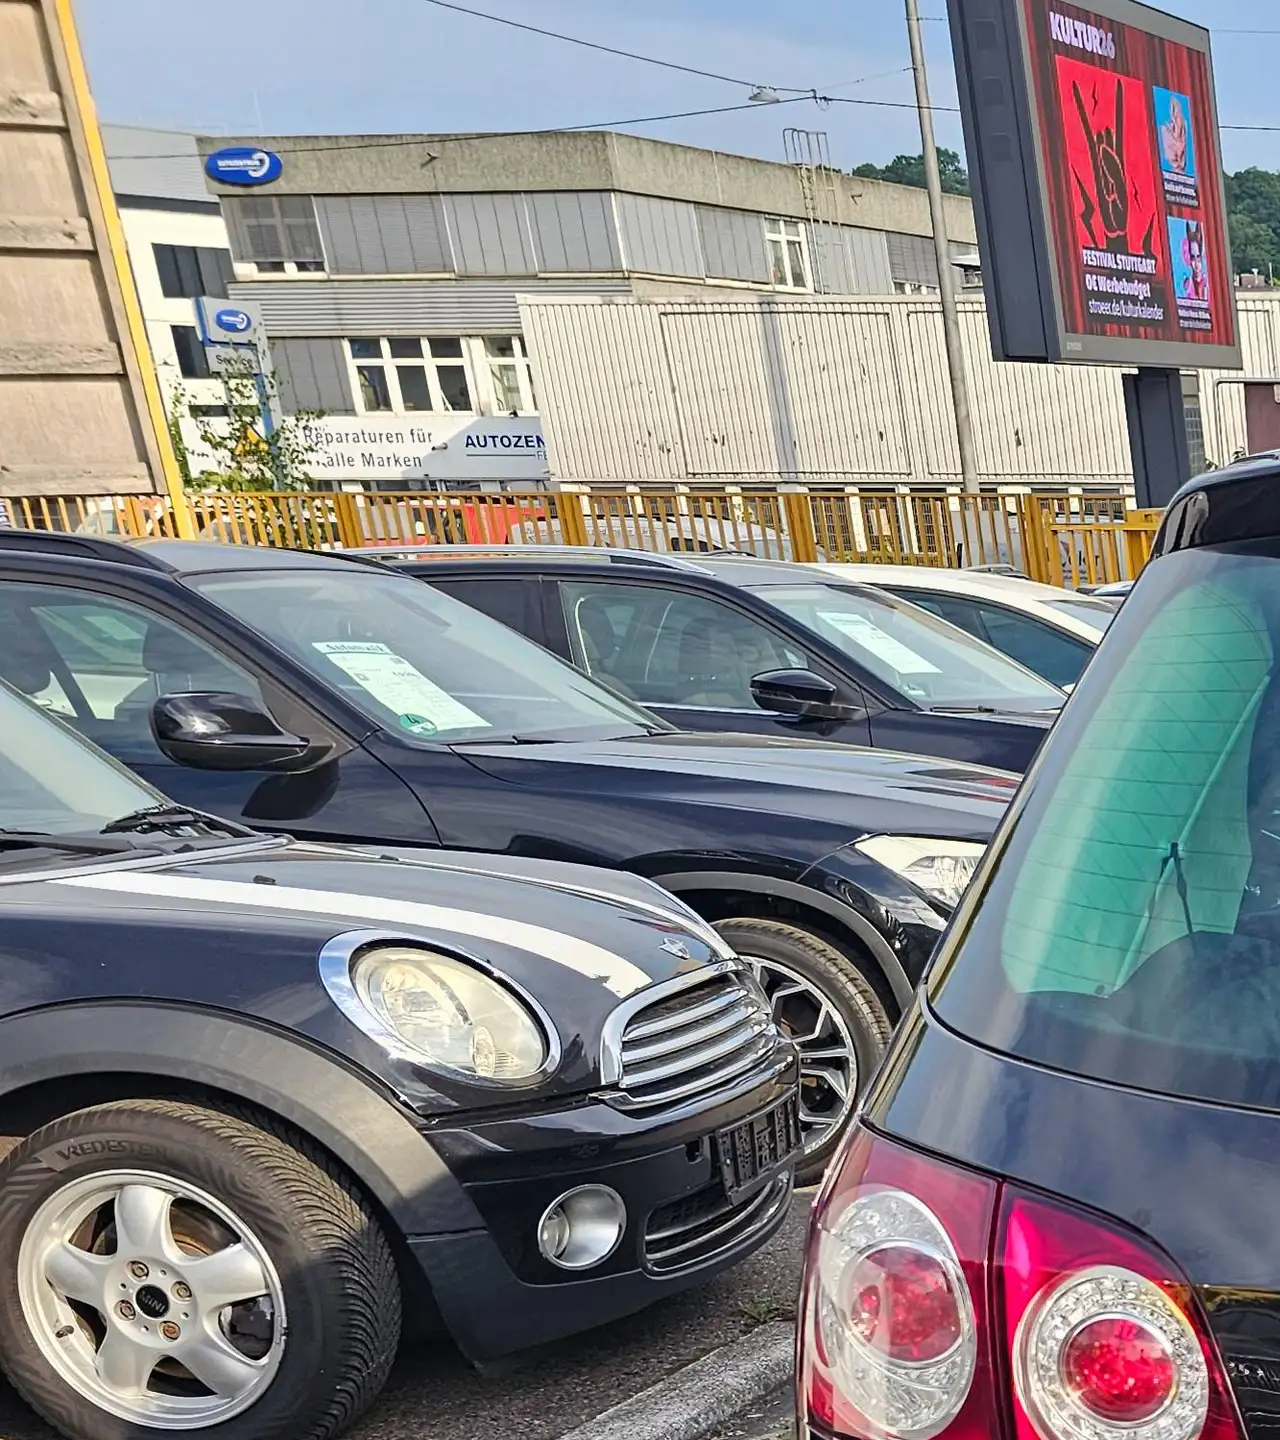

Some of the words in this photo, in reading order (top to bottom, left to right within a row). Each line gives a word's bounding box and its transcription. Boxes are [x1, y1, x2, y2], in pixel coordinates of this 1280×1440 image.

[1082, 249, 1117, 269] FESTIVAL
[215, 354, 253, 367] Servce
[303, 426, 405, 446] Reparaturen
[410, 428, 433, 444] für
[465, 434, 546, 449] AUTOZEN
[326, 452, 356, 468] alle
[361, 452, 423, 468] Marken
